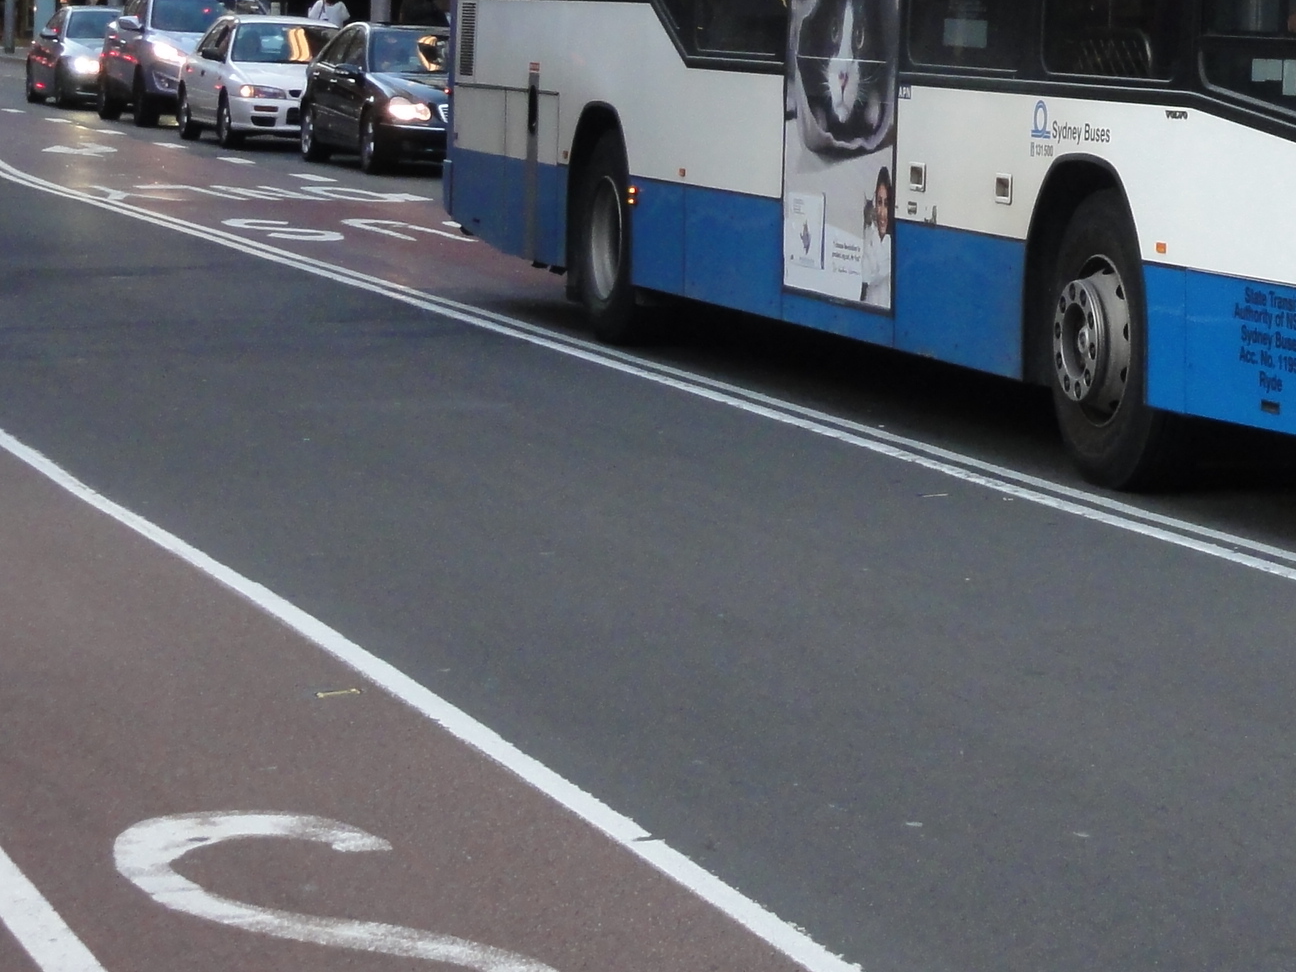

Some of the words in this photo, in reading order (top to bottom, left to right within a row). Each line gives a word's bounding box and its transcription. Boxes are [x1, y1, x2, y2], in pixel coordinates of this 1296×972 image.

[1165, 110, 1188, 120] VOLVO
[1052, 120, 1082, 145] Sydney
[1084, 123, 1111, 143] Buses
[1245, 287, 1267, 307] State
[1234, 302, 1273, 329] Authority
[1275, 311, 1285, 328] of
[1241, 325, 1274, 351] Sydney
[1239, 346, 1259, 365] Acc.
[1260, 349, 1276, 369] No.
[1259, 371, 1283, 393] Ryde
